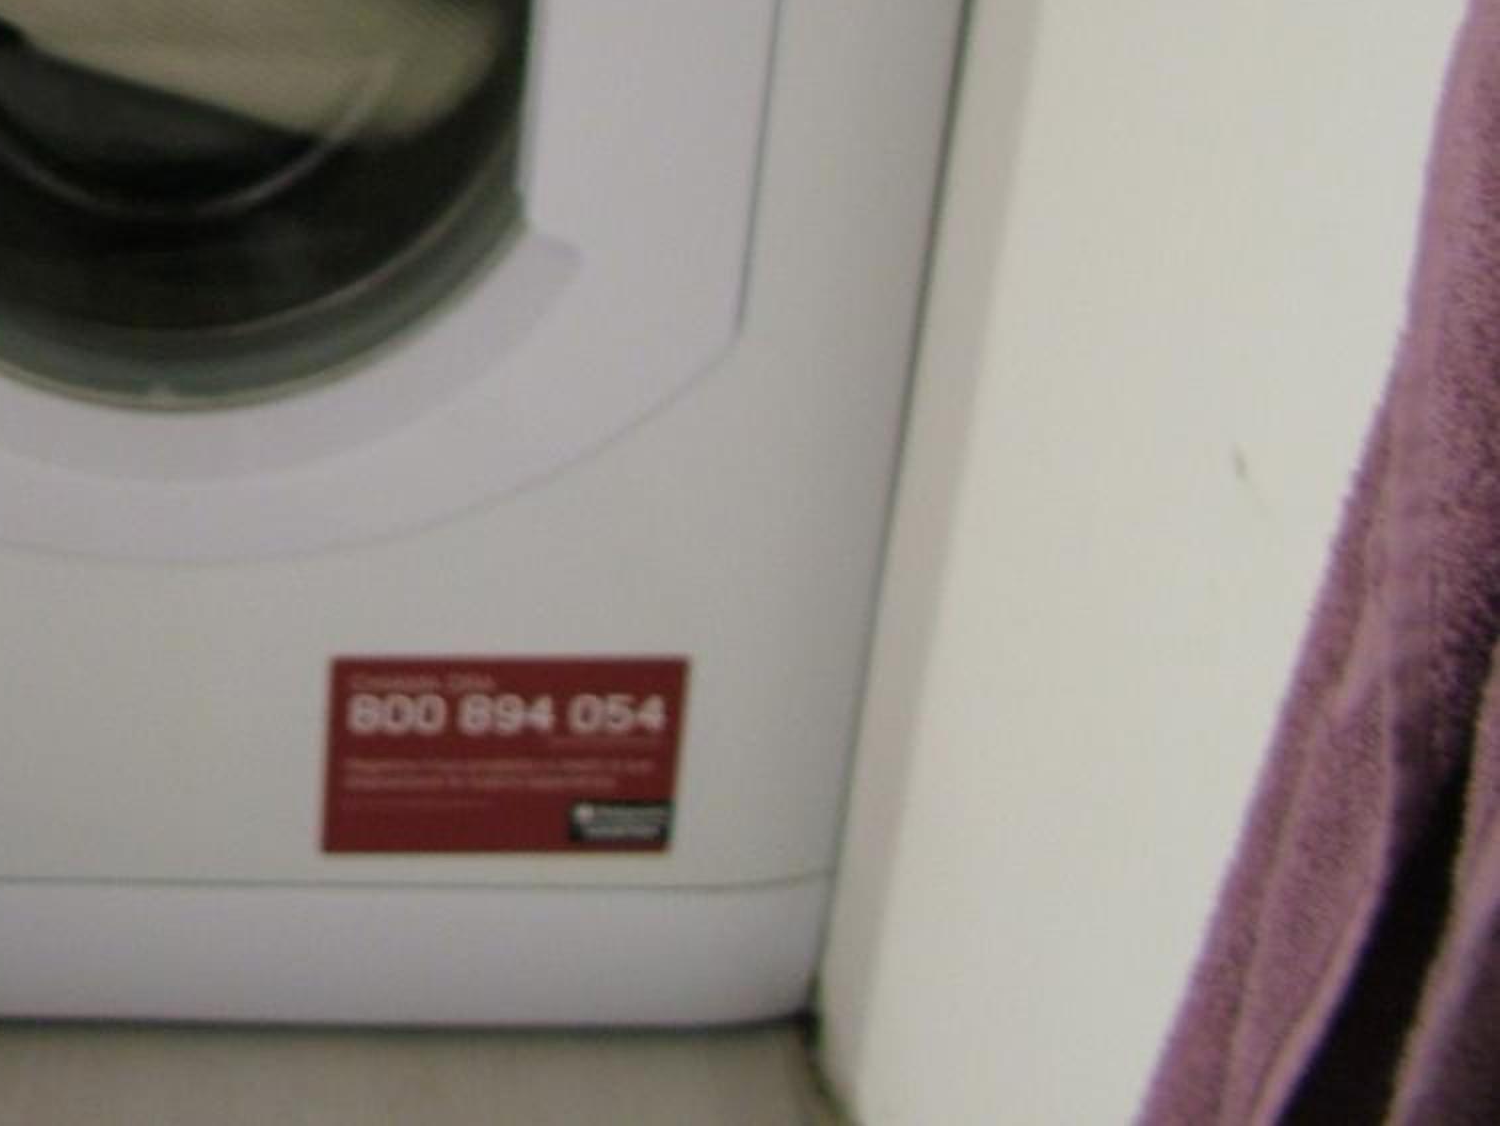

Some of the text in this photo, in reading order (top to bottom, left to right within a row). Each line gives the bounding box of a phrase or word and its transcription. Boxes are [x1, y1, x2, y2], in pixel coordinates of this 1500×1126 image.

[346, 693, 666, 736] 800 894 054
